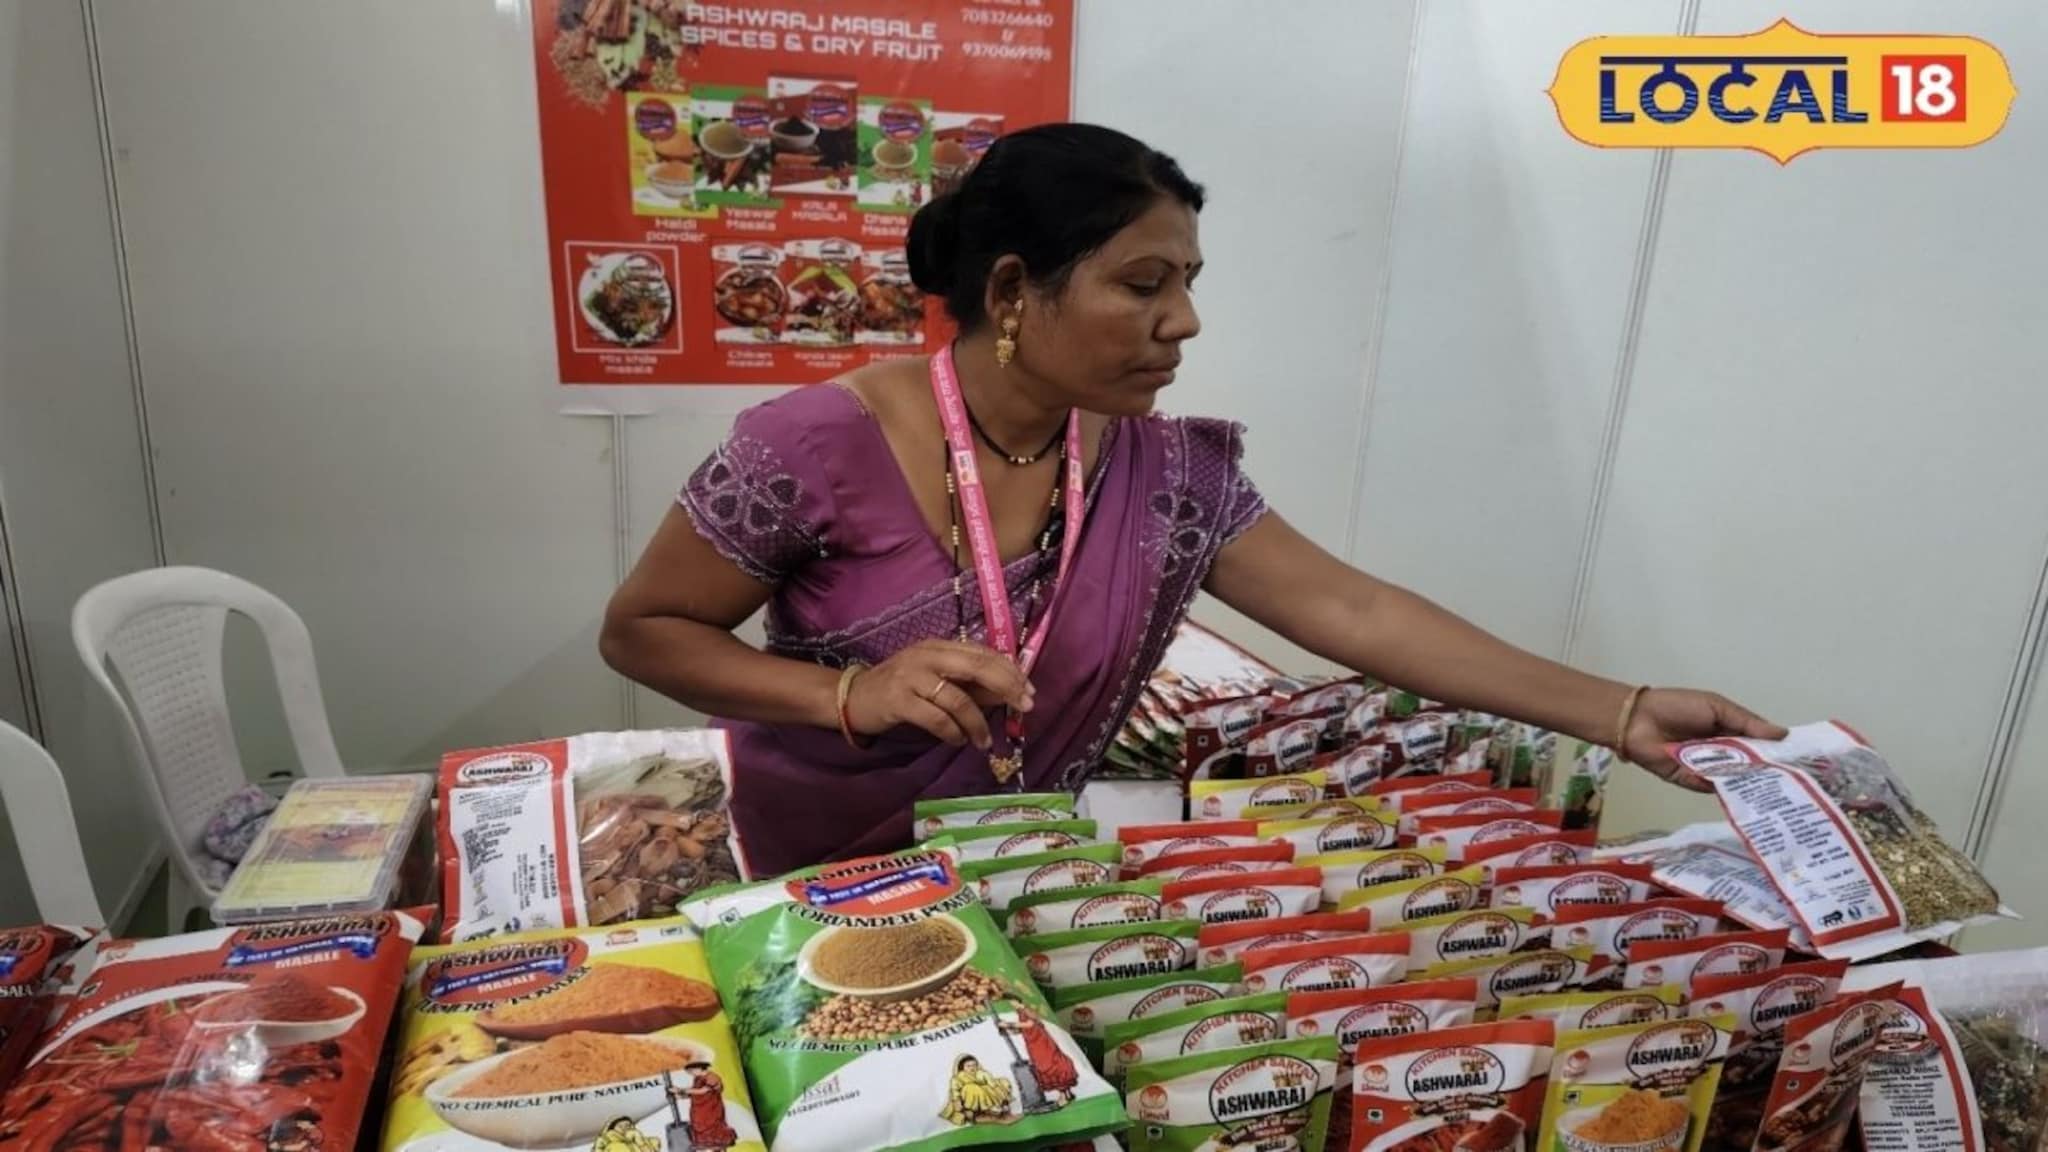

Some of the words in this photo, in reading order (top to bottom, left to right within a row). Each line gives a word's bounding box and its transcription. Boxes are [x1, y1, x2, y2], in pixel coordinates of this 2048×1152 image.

[686, 5, 824, 32] ASHWRAJ
[831, 15, 936, 40] MASALE
[681, 25, 777, 49] SPICES
[784, 33, 803, 51] &
[812, 35, 865, 56] DRY
[872, 40, 943, 61] FRUIT
[469, 765, 533, 776] ASHWARAJ
[866, 880, 927, 905] MASALE
[787, 903, 916, 928] CORIANDER
[1206, 907, 1268, 923] ASHWARAJ
[1444, 936, 1506, 952] ASHWARAJ
[275, 951, 341, 968] MASALE
[1096, 959, 1173, 981] ASHWARAJ
[477, 974, 536, 993] MASALE
[1495, 973, 1561, 991] ASHWARAJ
[768, 1039, 786, 1049] NO
[788, 1039, 874, 1052] CHEMICAL
[877, 1038, 920, 1051] PURE
[923, 1015, 988, 1043] NATURAL
[1185, 1013, 1232, 1050] KITCHEN
[1411, 1049, 1456, 1076] KITCHEN
[1215, 1057, 1265, 1094] KITCHEN
[1413, 1072, 1489, 1093] ASHWARAJ
[439, 1101, 460, 1111] NO
[464, 1097, 541, 1110] CHEMICAL
[548, 1092, 588, 1104] PURE
[593, 1079, 665, 1098] NATURAL
[1218, 1087, 1306, 1116] ASHWARAJ
